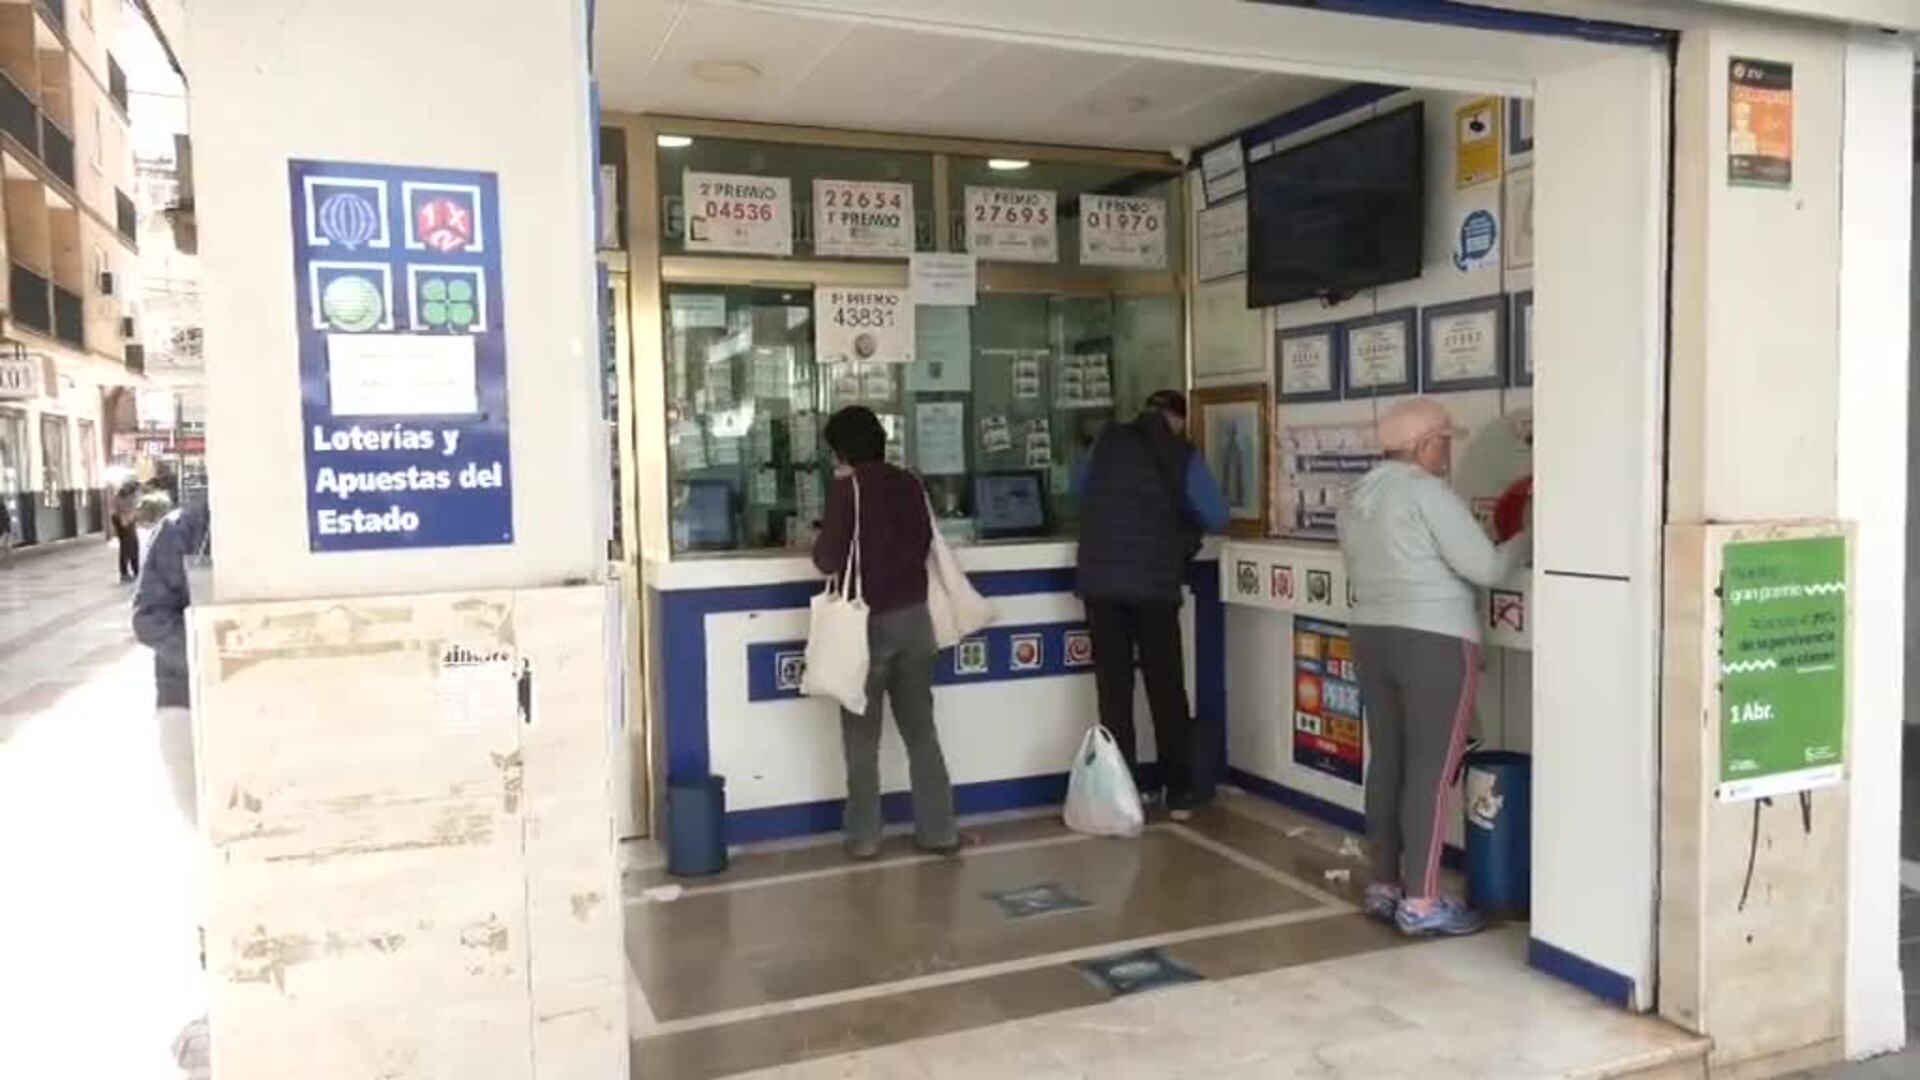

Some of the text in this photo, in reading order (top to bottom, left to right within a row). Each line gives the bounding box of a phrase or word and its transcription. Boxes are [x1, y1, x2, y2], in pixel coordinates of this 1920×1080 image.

[714, 183, 777, 201] PREMIO
[825, 189, 901, 210] 22654
[705, 201, 773, 222] 04536
[841, 212, 901, 229] PREMIO
[974, 205, 1050, 225] 27695
[1087, 212, 1158, 233] 01970
[313, 424, 460, 456] Loterías y
[315, 461, 502, 499] Apuestas del
[317, 505, 420, 535] Estado
[1730, 700, 1775, 724] 1 Abr.
